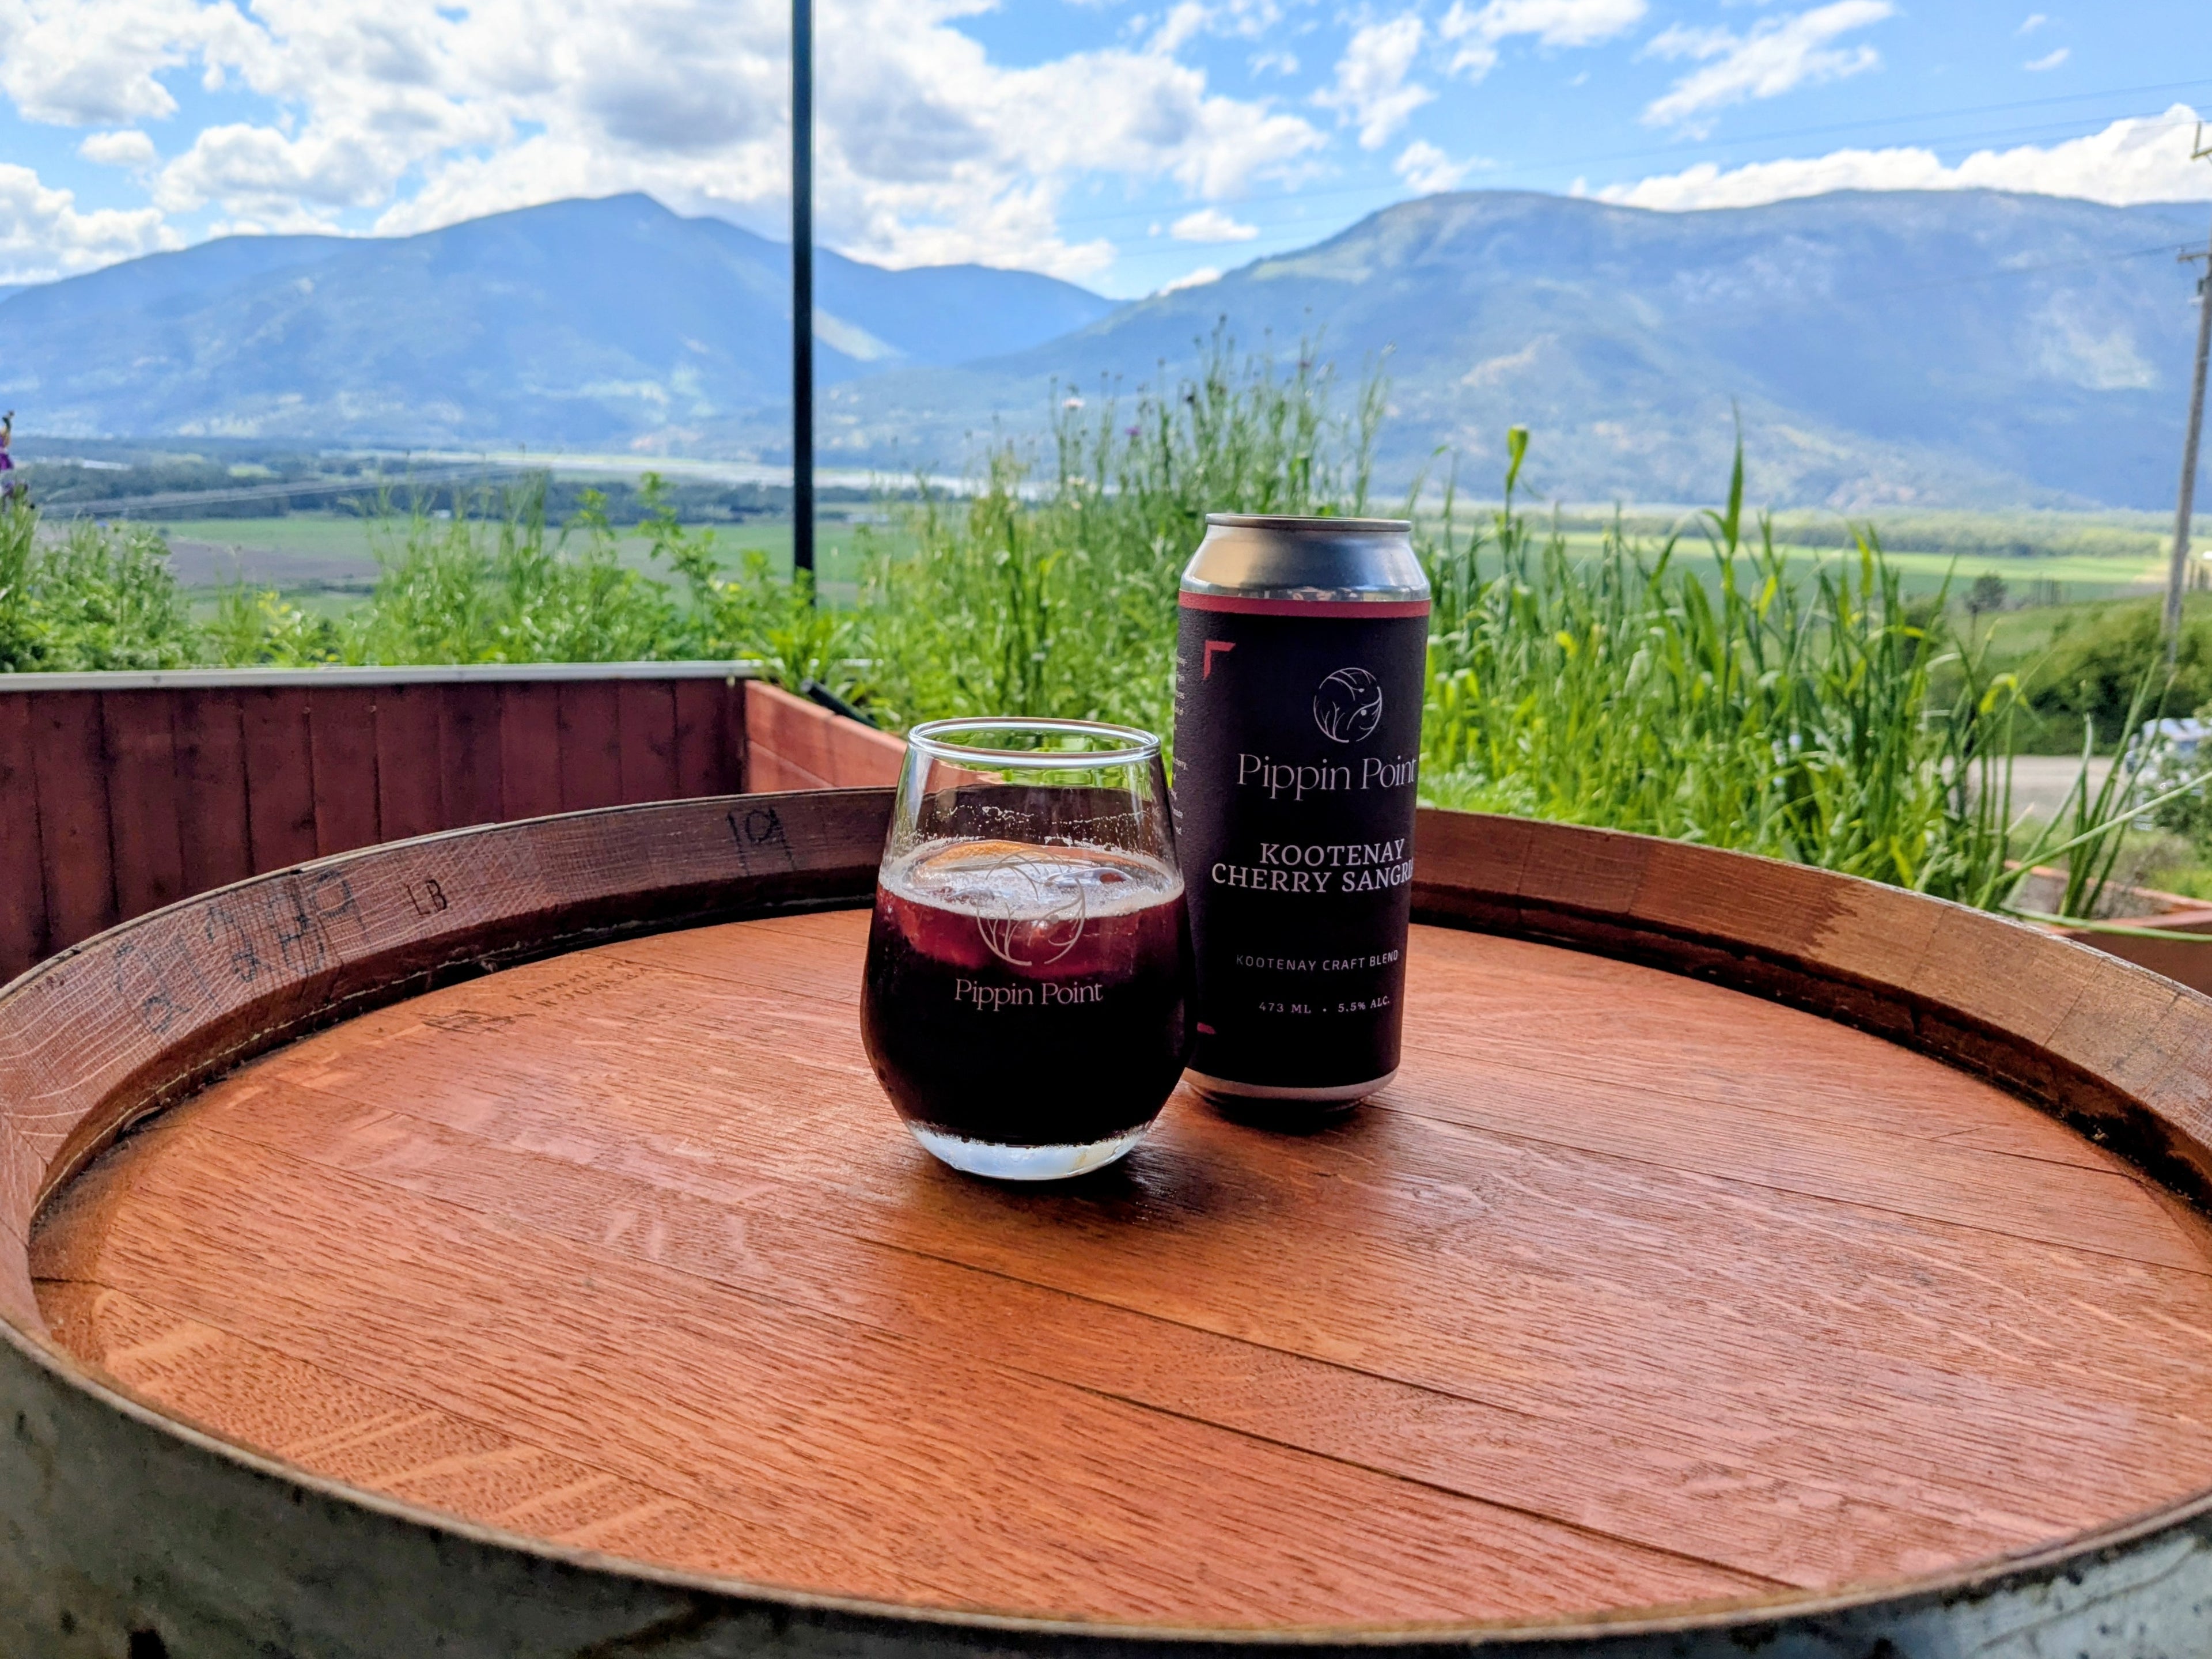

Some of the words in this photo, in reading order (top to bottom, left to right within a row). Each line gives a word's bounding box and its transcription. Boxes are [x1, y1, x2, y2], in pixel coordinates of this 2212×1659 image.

[1237, 753, 1351, 801] Pippin
[1360, 755, 1416, 790] Point
[1259, 838, 1406, 867] KOOTENAY
[1211, 863, 1332, 893] CHERRY
[1236, 954, 1317, 972] KOOTENAY
[1323, 957, 1365, 971] CRAFT
[1369, 949, 1399, 967] BLEND
[955, 978, 1034, 1012] Pippin
[1041, 981, 1104, 1005] Point
[1259, 1002, 1284, 1013] 473
[1290, 1003, 1312, 1014] ML
[1338, 1002, 1366, 1013] 5.5%
[1370, 995, 1390, 1009] ALC.
